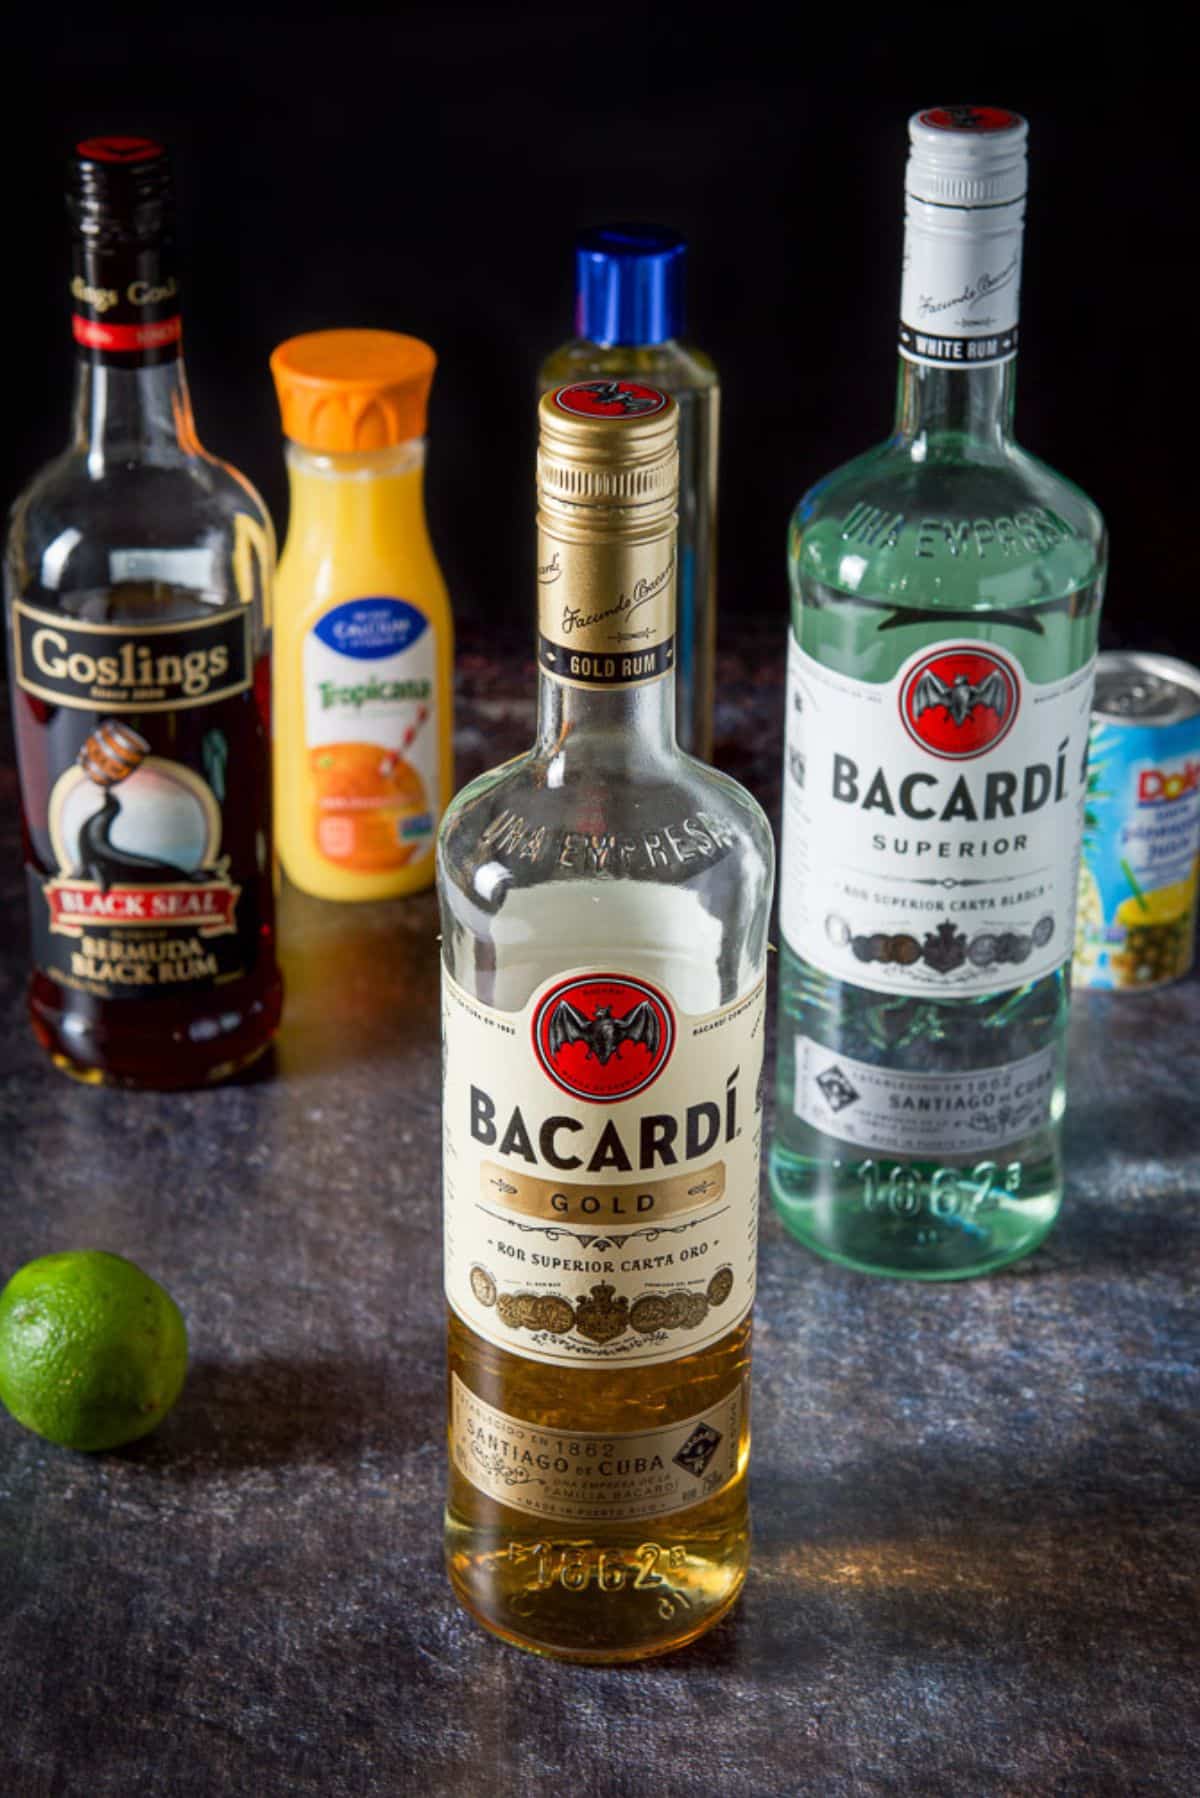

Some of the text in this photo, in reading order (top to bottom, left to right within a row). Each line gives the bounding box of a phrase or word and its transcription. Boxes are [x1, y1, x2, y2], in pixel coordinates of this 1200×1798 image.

[914, 335, 998, 358] WHITE RUM
[561, 594, 632, 634] Facundo
[32, 629, 229, 694] Goslings
[570, 653, 656, 678] GOLD RUM
[318, 674, 430, 708] Tropicana
[832, 735, 1067, 822] BACARDÍ
[872, 834, 1028, 859] SUPERIOR
[59, 890, 216, 917] BLACK SEAL
[873, 893, 945, 912] SUPERIOR
[950, 897, 996, 912] CARTA
[81, 935, 204, 963] BERMUDA
[71, 952, 154, 984] BLACK
[158, 952, 218, 983] RUM
[888, 1093, 995, 1111] SANTIAGO
[470, 1064, 740, 1173] BACARDÍ
[551, 1193, 655, 1213] GOLD
[497, 1241, 709, 1273] RON SUPERIOR CARTA ORO
[467, 1417, 569, 1474] SANTIAGO
[597, 1455, 665, 1477] CUBA
[555, 1440, 615, 1458] 1862
[543, 1486, 606, 1501] FAMILIA
